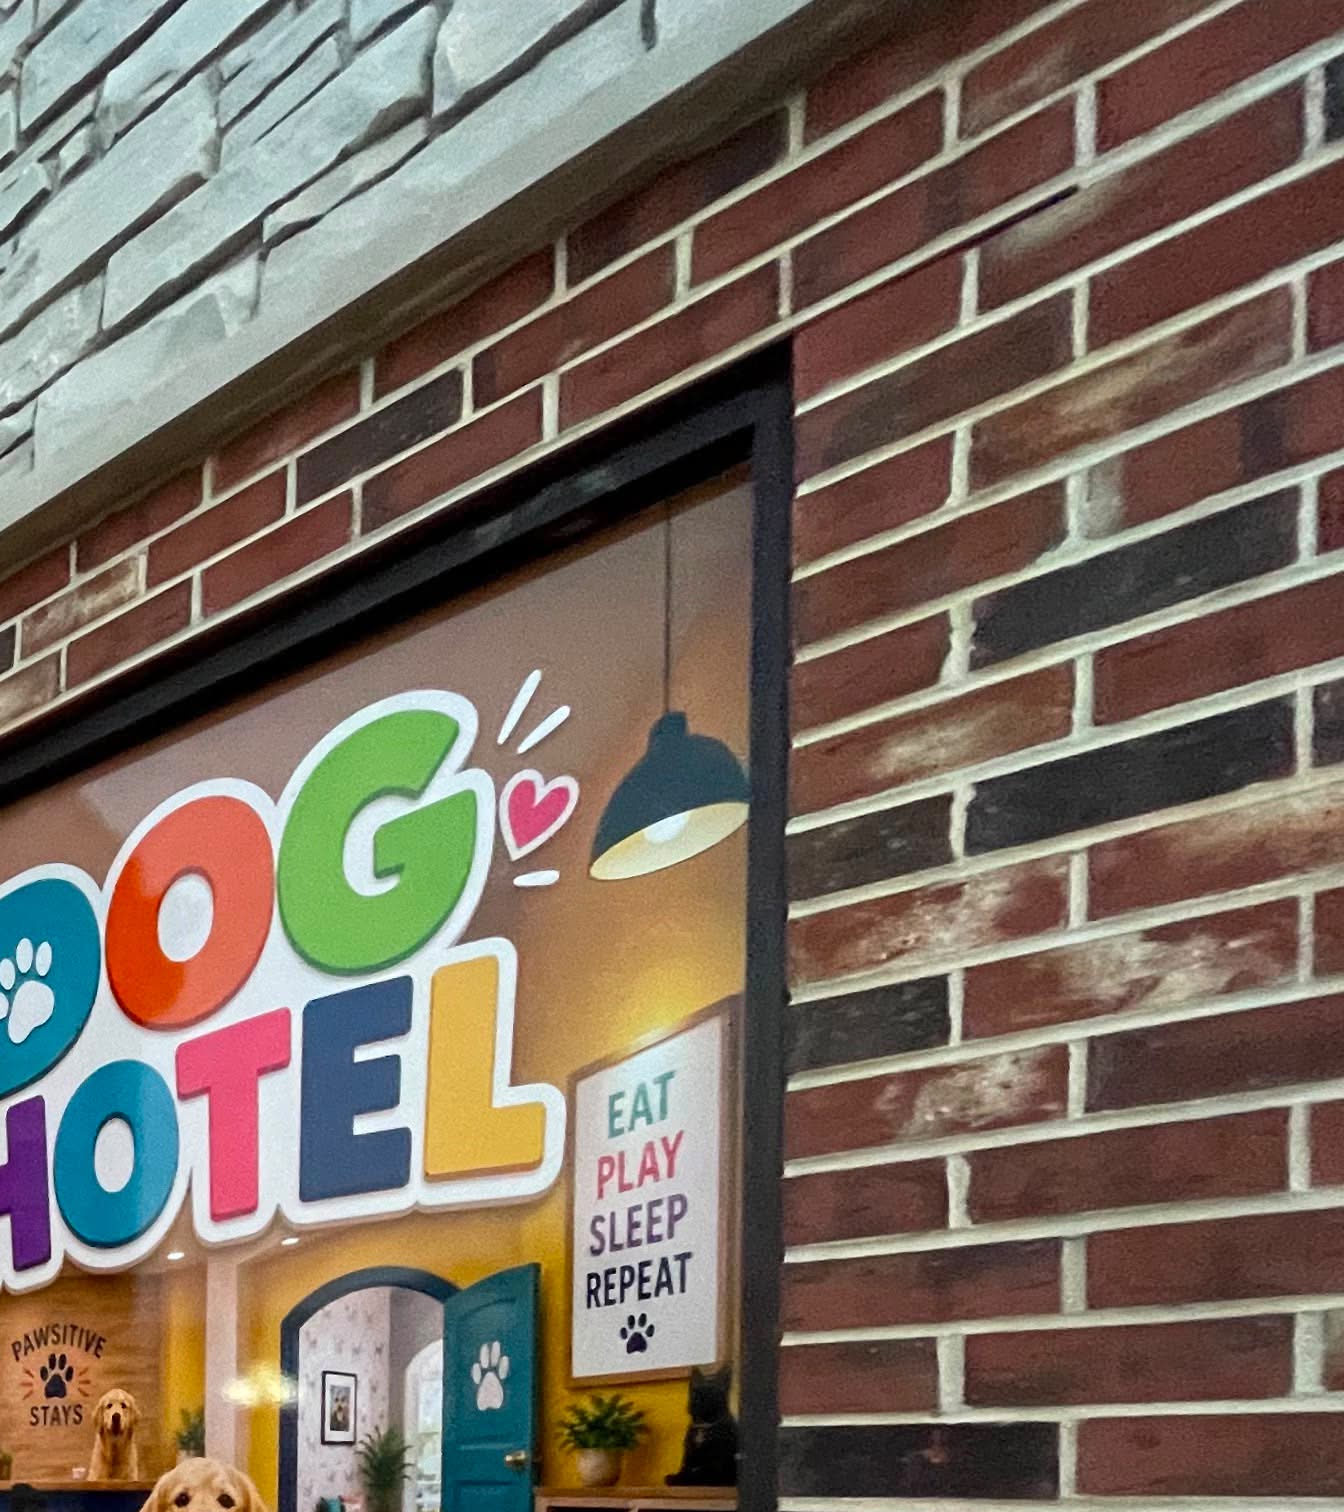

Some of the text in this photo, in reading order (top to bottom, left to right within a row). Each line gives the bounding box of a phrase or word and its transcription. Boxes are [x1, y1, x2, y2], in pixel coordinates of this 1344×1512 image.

[608, 1070, 676, 1139] EAT
[597, 1129, 684, 1200] PLAY
[589, 1193, 689, 1257] SLEEP
[586, 1251, 694, 1310] REPEAT
[11, 1322, 107, 1363] PAWSITIVE
[29, 1403, 83, 1427] STAYS
